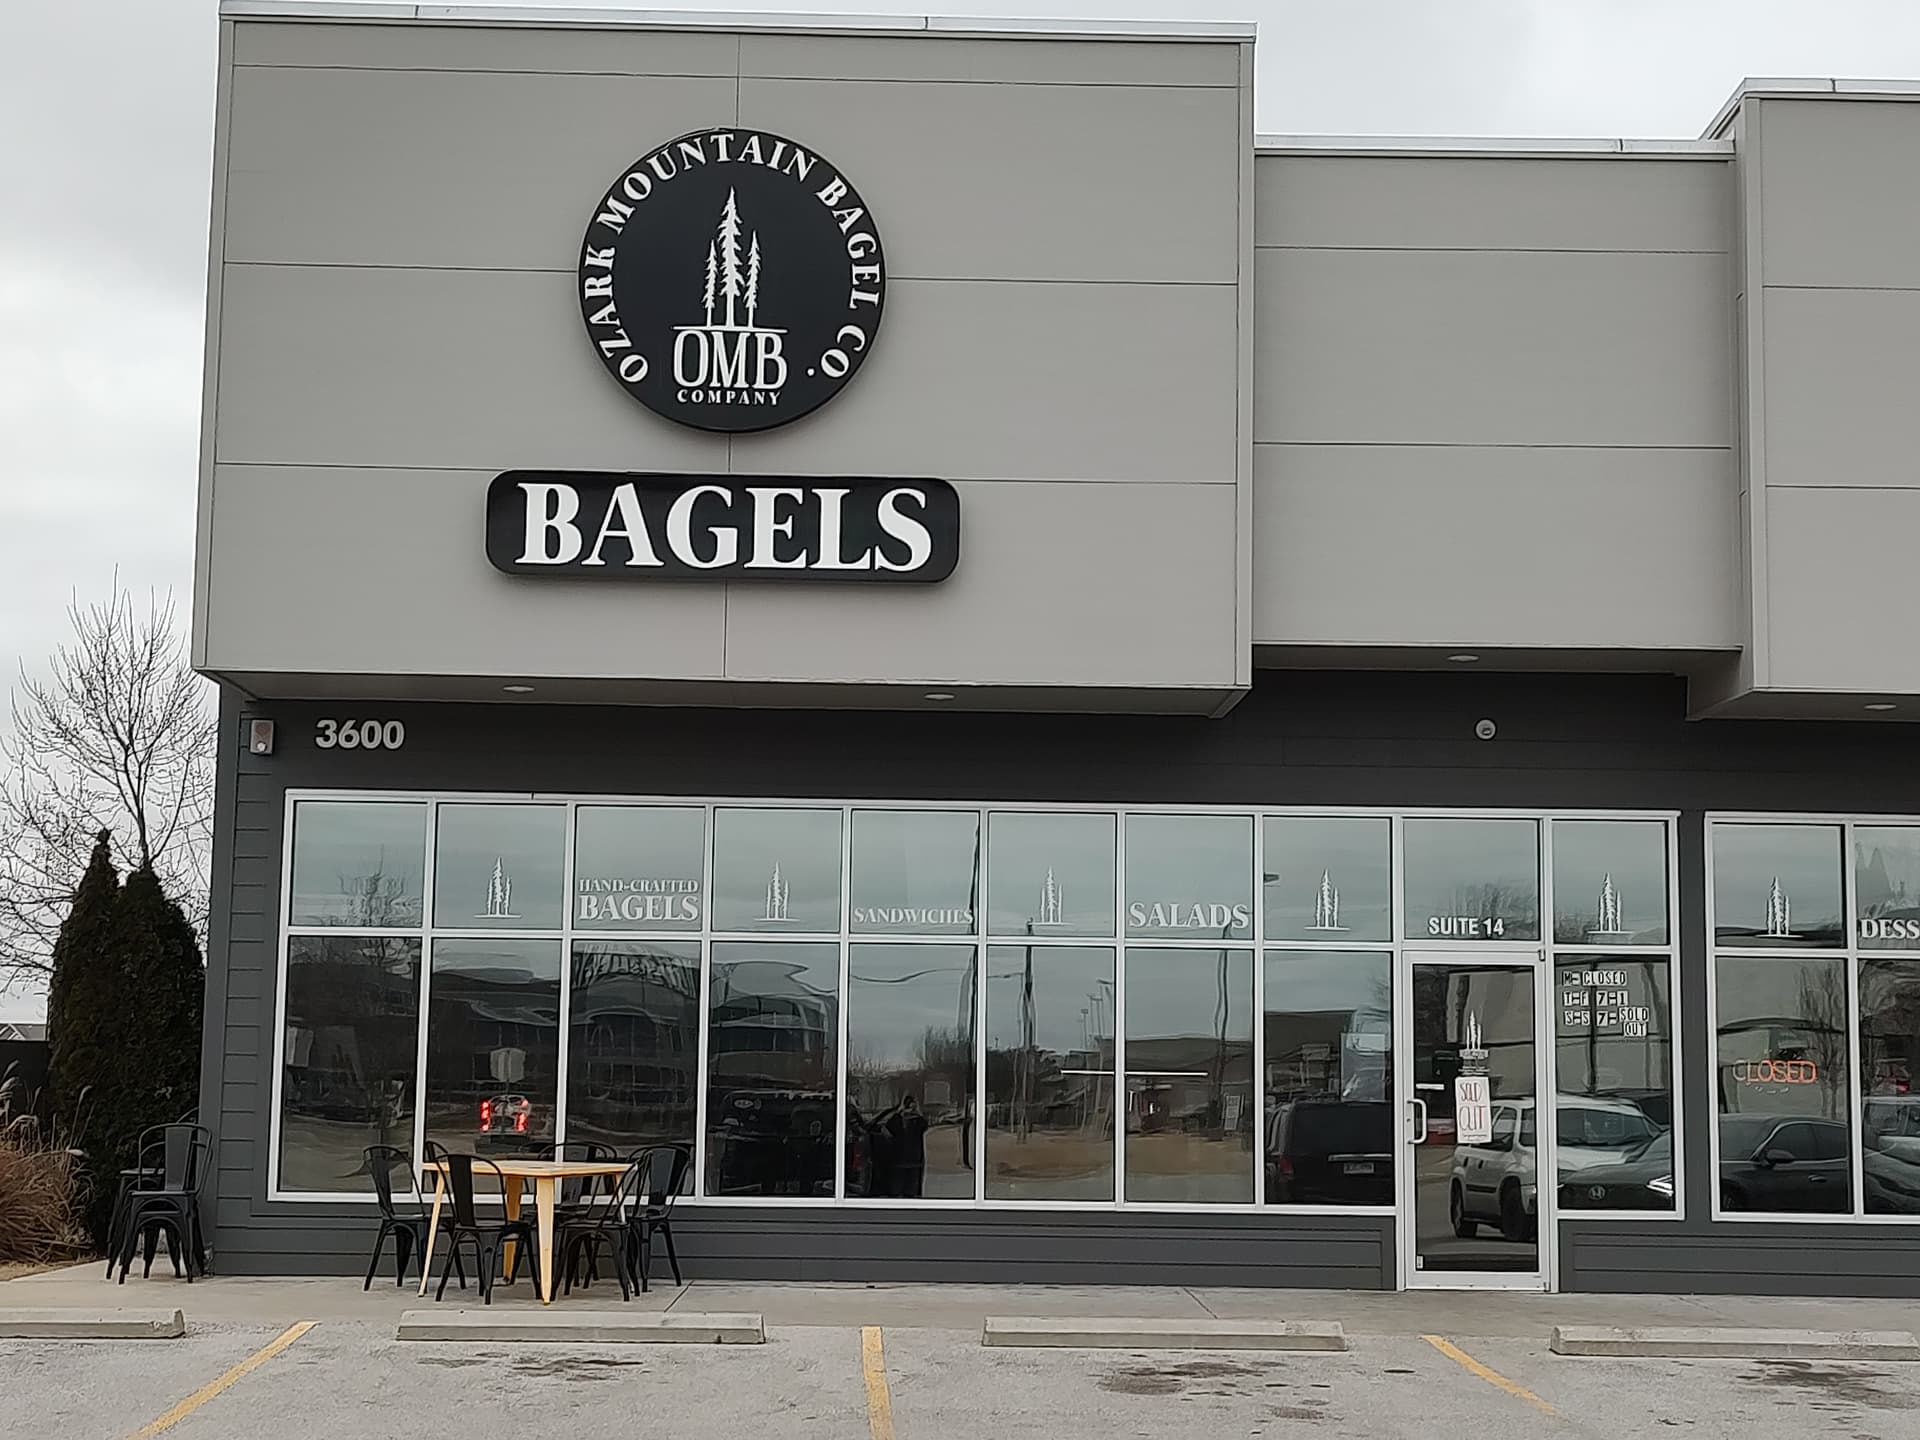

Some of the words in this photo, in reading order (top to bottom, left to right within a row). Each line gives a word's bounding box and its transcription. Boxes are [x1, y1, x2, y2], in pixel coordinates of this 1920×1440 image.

[596, 133, 818, 235] MOUNTAIN
[815, 175, 881, 310] BAGEL
[584, 244, 649, 383] OZARK
[672, 329, 788, 390] OMB
[806, 324, 867, 379] CO.
[676, 389, 782, 406] COMPANY
[514, 482, 932, 572] BAGELS
[315, 719, 405, 750] 3600
[578, 879, 699, 893] HAND-CRAFTED
[578, 894, 699, 921] BAGELS
[854, 907, 974, 925] SANDWICHES
[1128, 902, 1249, 929] SALADS
[1428, 916, 1479, 935] SUITE
[1482, 917, 1504, 936] 14
[1860, 918, 1920, 940] DESS
[1624, 1022, 1647, 1036] OUT
[1732, 1059, 1817, 1083] CLOSED
[1460, 1105, 1487, 1130] OUT
